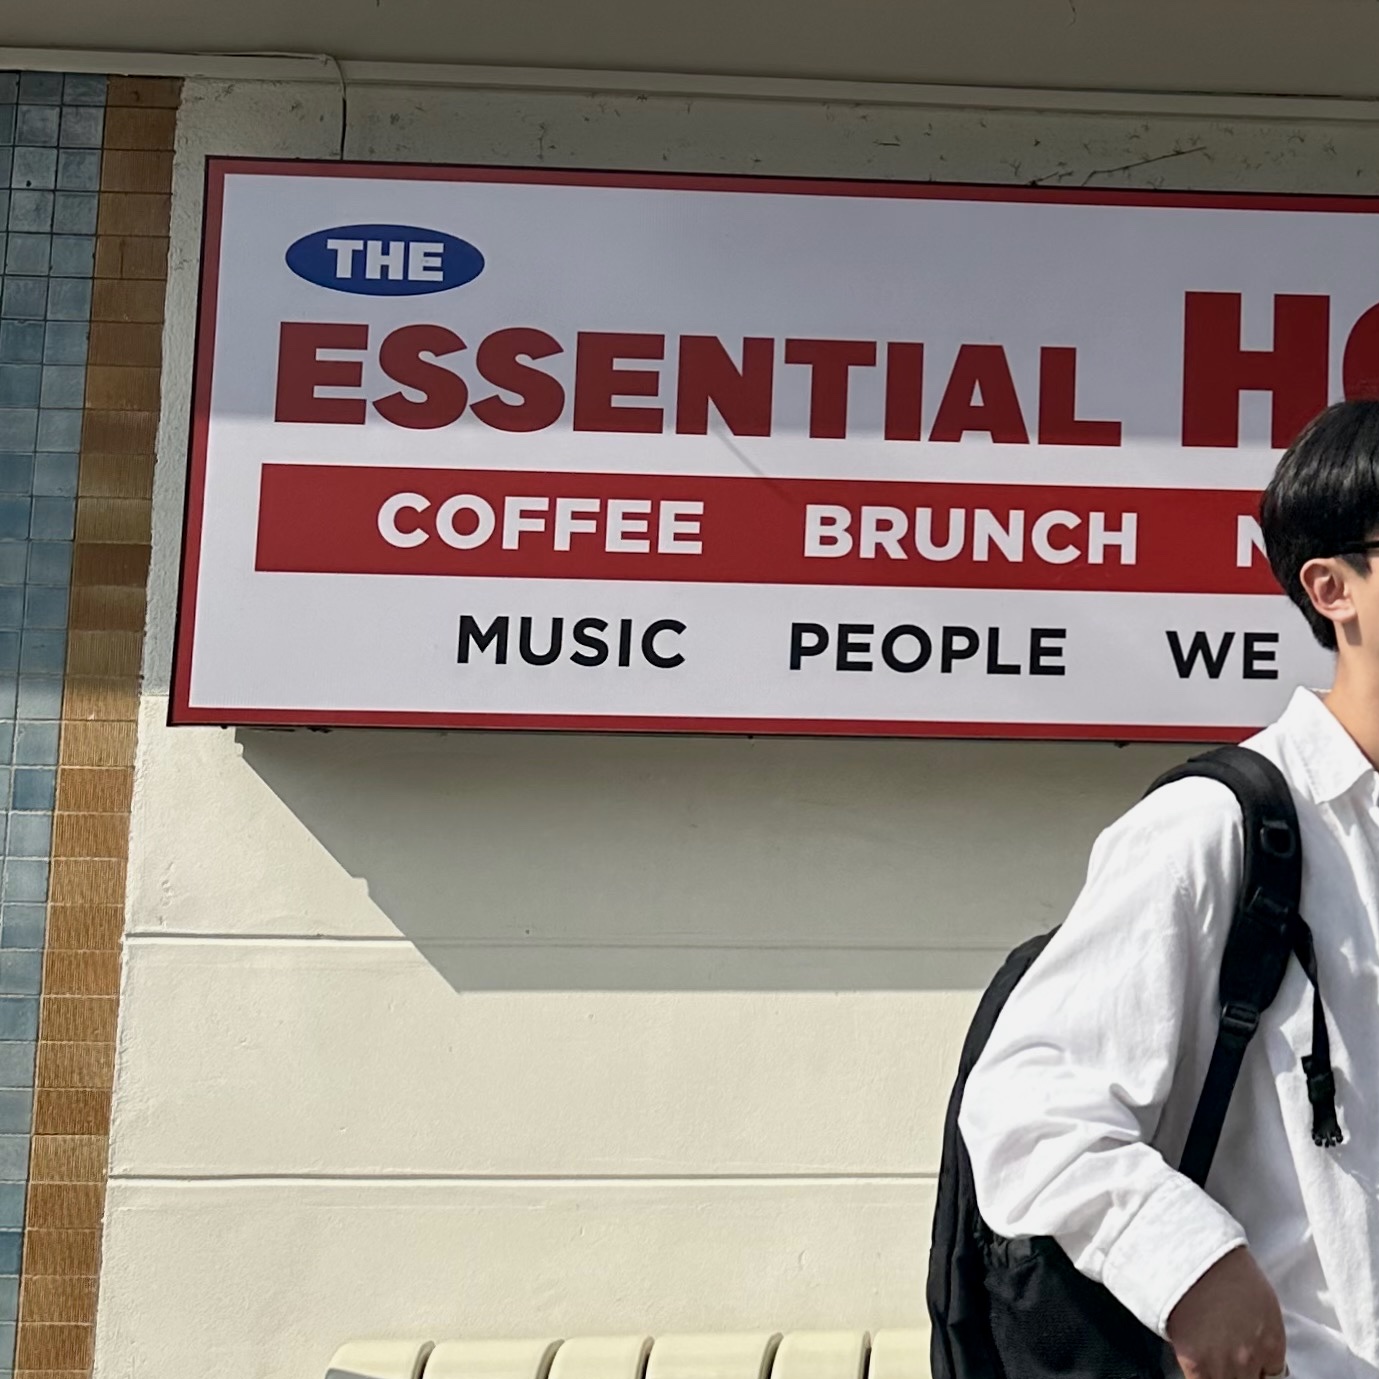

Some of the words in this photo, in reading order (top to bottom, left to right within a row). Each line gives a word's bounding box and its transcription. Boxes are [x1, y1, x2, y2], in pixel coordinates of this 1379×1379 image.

[326, 238, 445, 282] THE
[274, 321, 1123, 447] ESSENTIAL
[377, 491, 704, 555] COFFEE
[803, 503, 1138, 565] BRUNCH
[456, 614, 688, 670] MUSIC
[789, 622, 1068, 676] PEOPLE
[1165, 629, 1280, 680] WE
